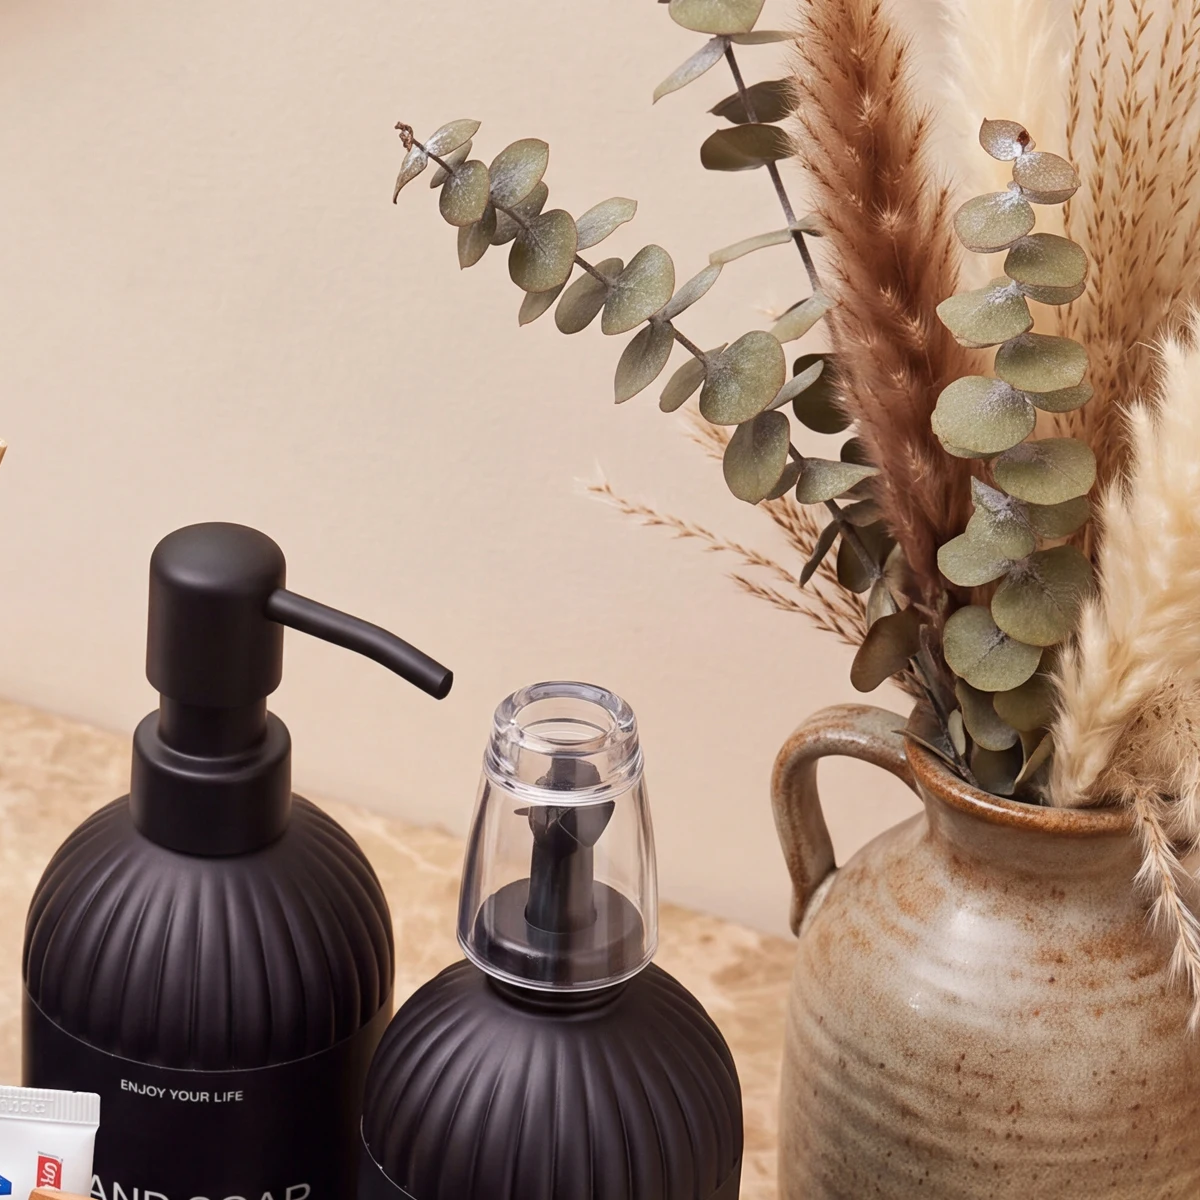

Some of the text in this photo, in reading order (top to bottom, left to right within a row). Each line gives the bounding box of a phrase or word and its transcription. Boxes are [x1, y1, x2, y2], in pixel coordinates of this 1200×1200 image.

[120, 1078, 243, 1103] ENJOY YOUR LIFE
